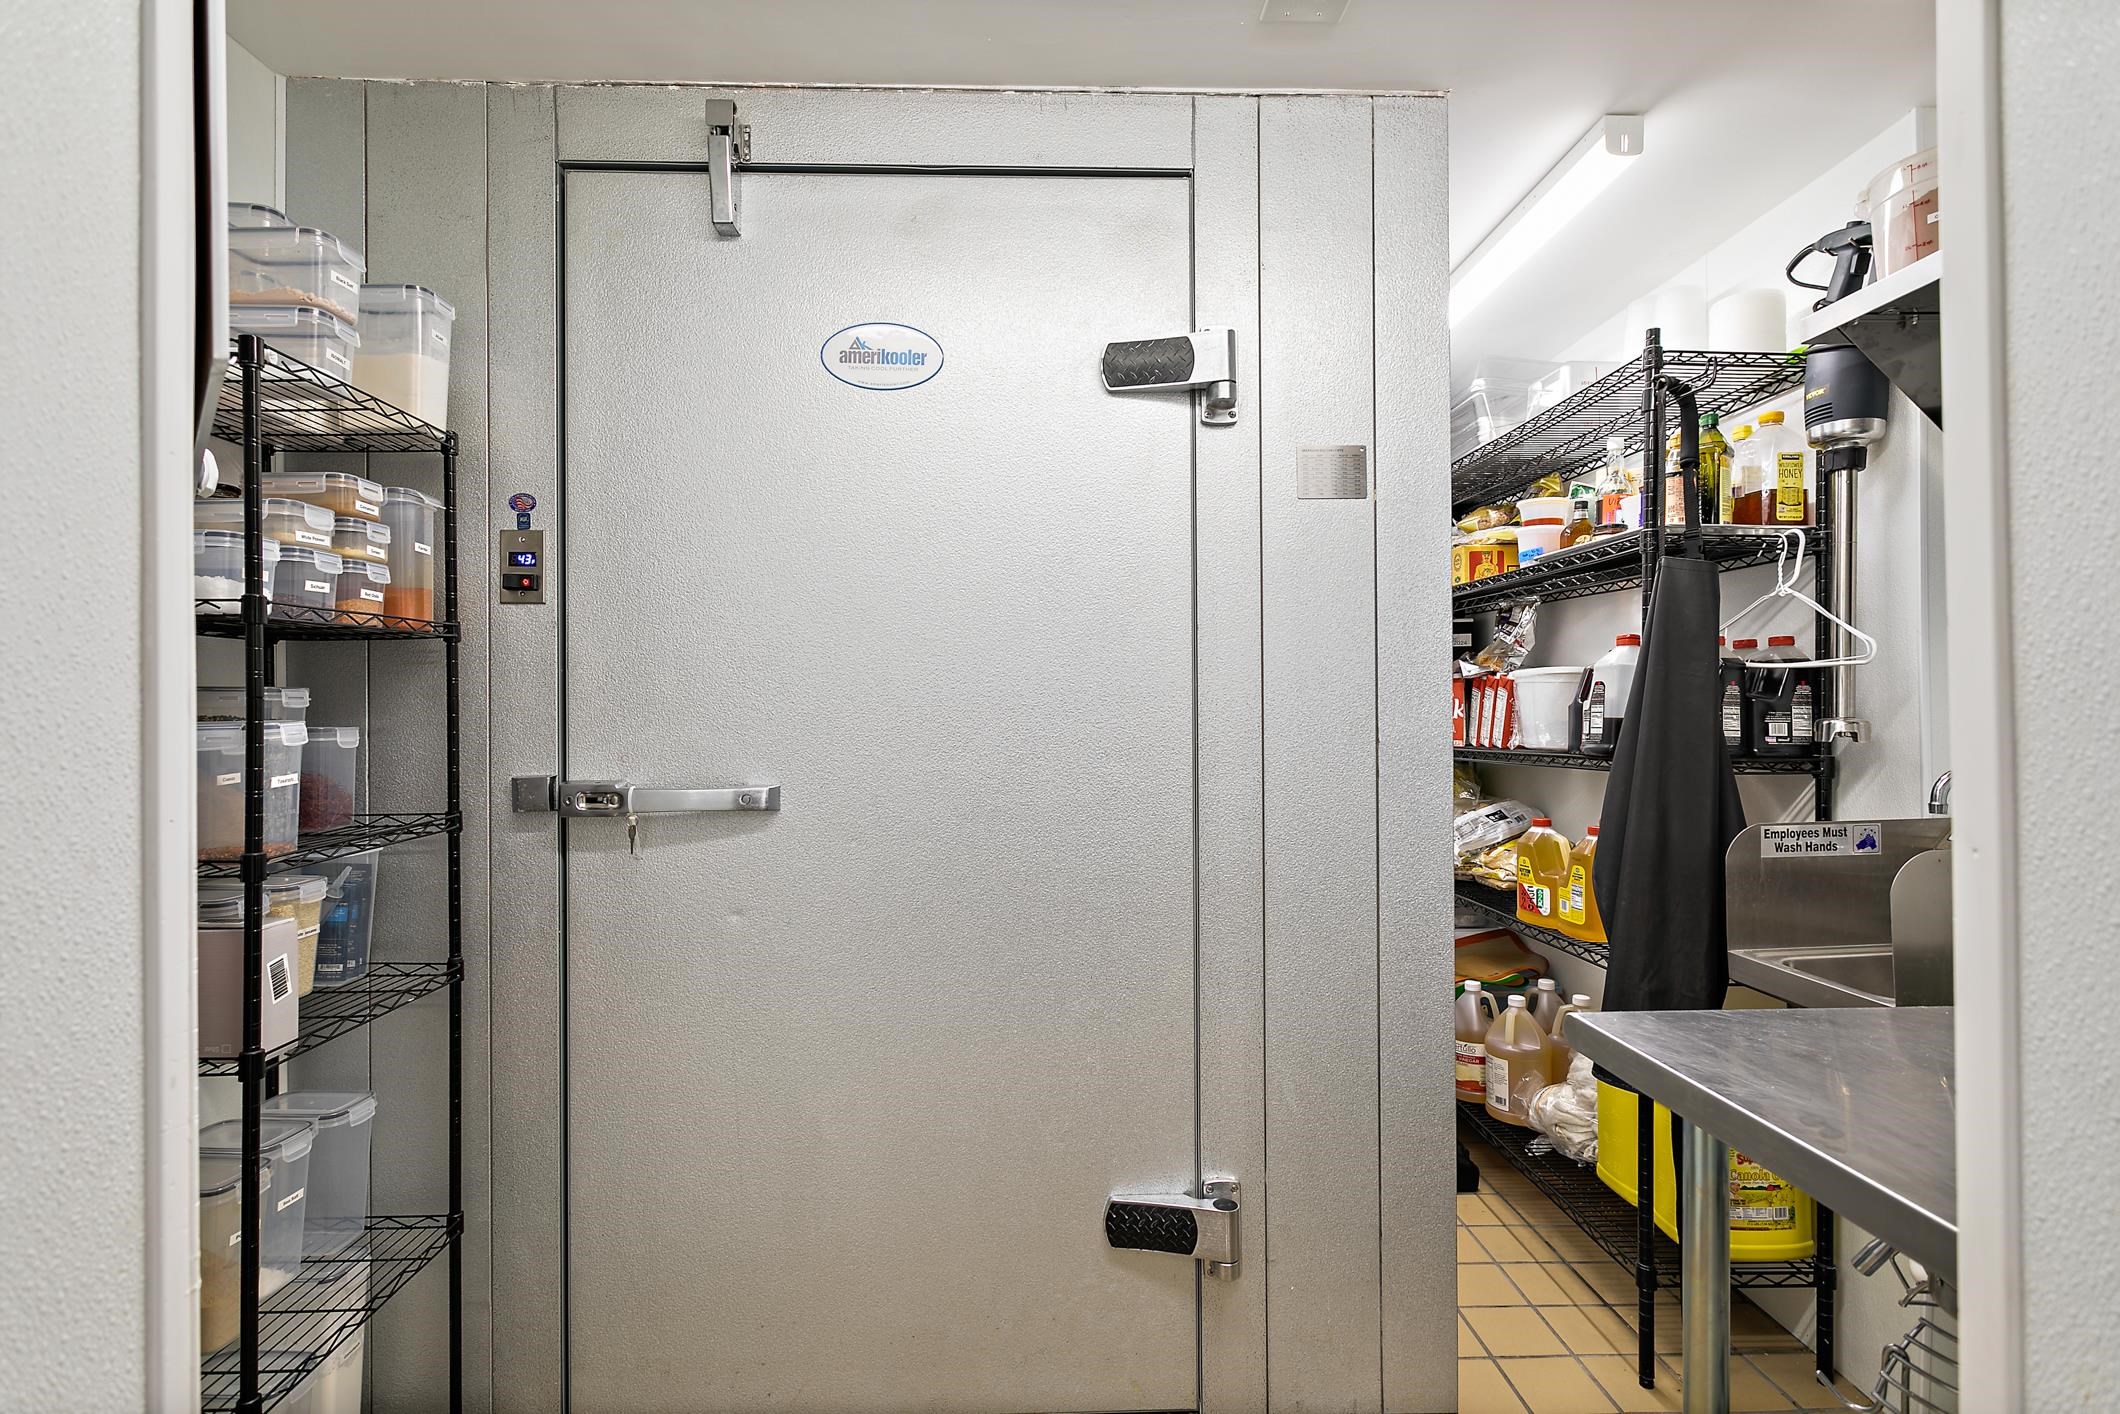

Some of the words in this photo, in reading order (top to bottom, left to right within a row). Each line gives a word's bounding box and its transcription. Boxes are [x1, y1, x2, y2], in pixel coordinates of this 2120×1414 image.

[839, 348, 927, 366] amerikooler
[1778, 468, 1803, 479] HONEY
[1764, 829, 1820, 841] Employees
[1822, 827, 1848, 838] Must
[1774, 842, 1802, 853] Wash
[1805, 841, 1838, 852] Hands
[1729, 1168, 1770, 1181] Canola
